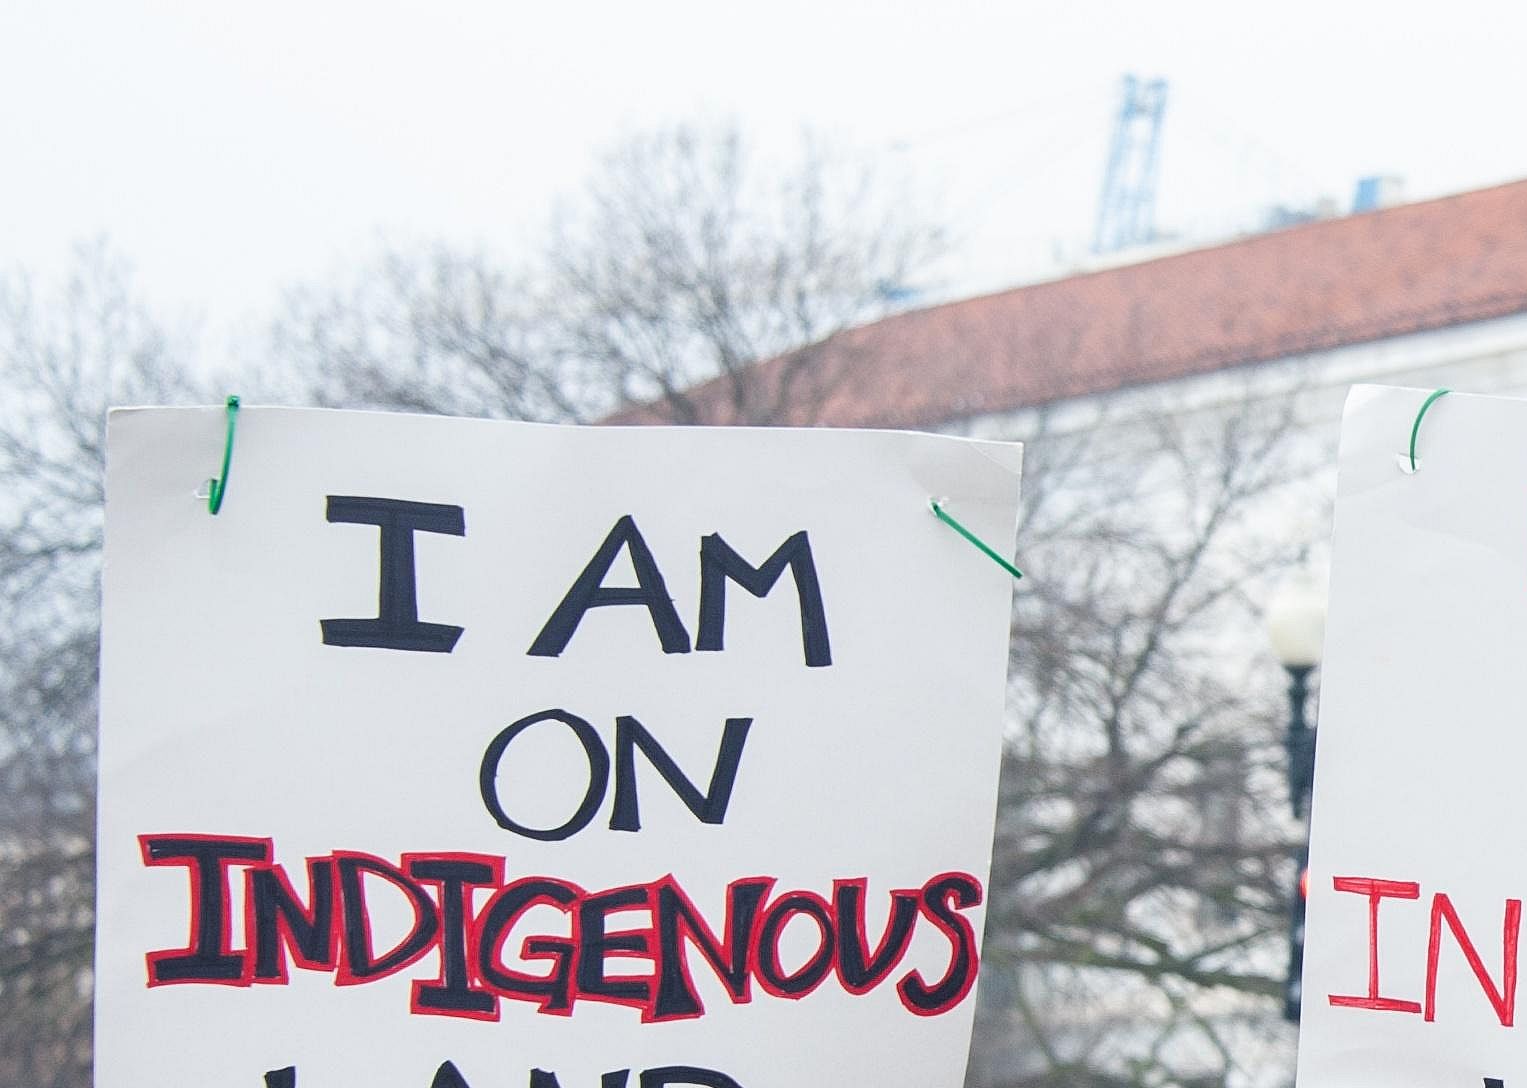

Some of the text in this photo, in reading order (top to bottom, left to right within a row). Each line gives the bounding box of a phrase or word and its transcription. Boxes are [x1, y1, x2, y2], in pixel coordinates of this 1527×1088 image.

[319, 495, 833, 668] I AM
[479, 708, 754, 842] ON
[137, 832, 983, 1025] INDIGENOUS
